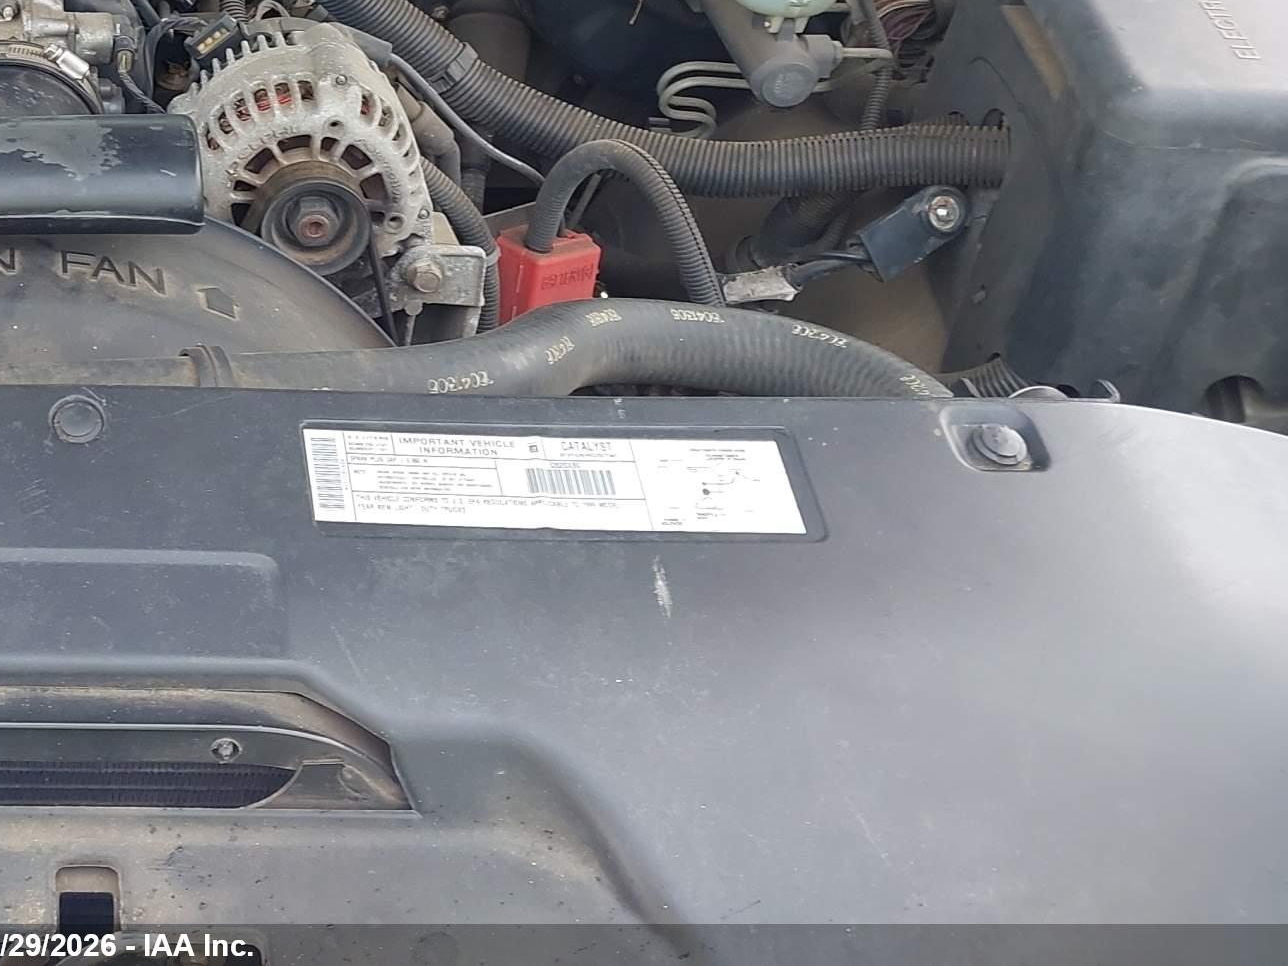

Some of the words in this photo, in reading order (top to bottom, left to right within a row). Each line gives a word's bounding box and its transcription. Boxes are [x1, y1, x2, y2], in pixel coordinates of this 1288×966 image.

[58, 249, 168, 297] FAN
[399, 438, 465, 447] IMPORTANT
[470, 440, 516, 449] VEHICLE
[560, 441, 613, 452] CATALYST
[419, 447, 499, 457] INFORMATION
